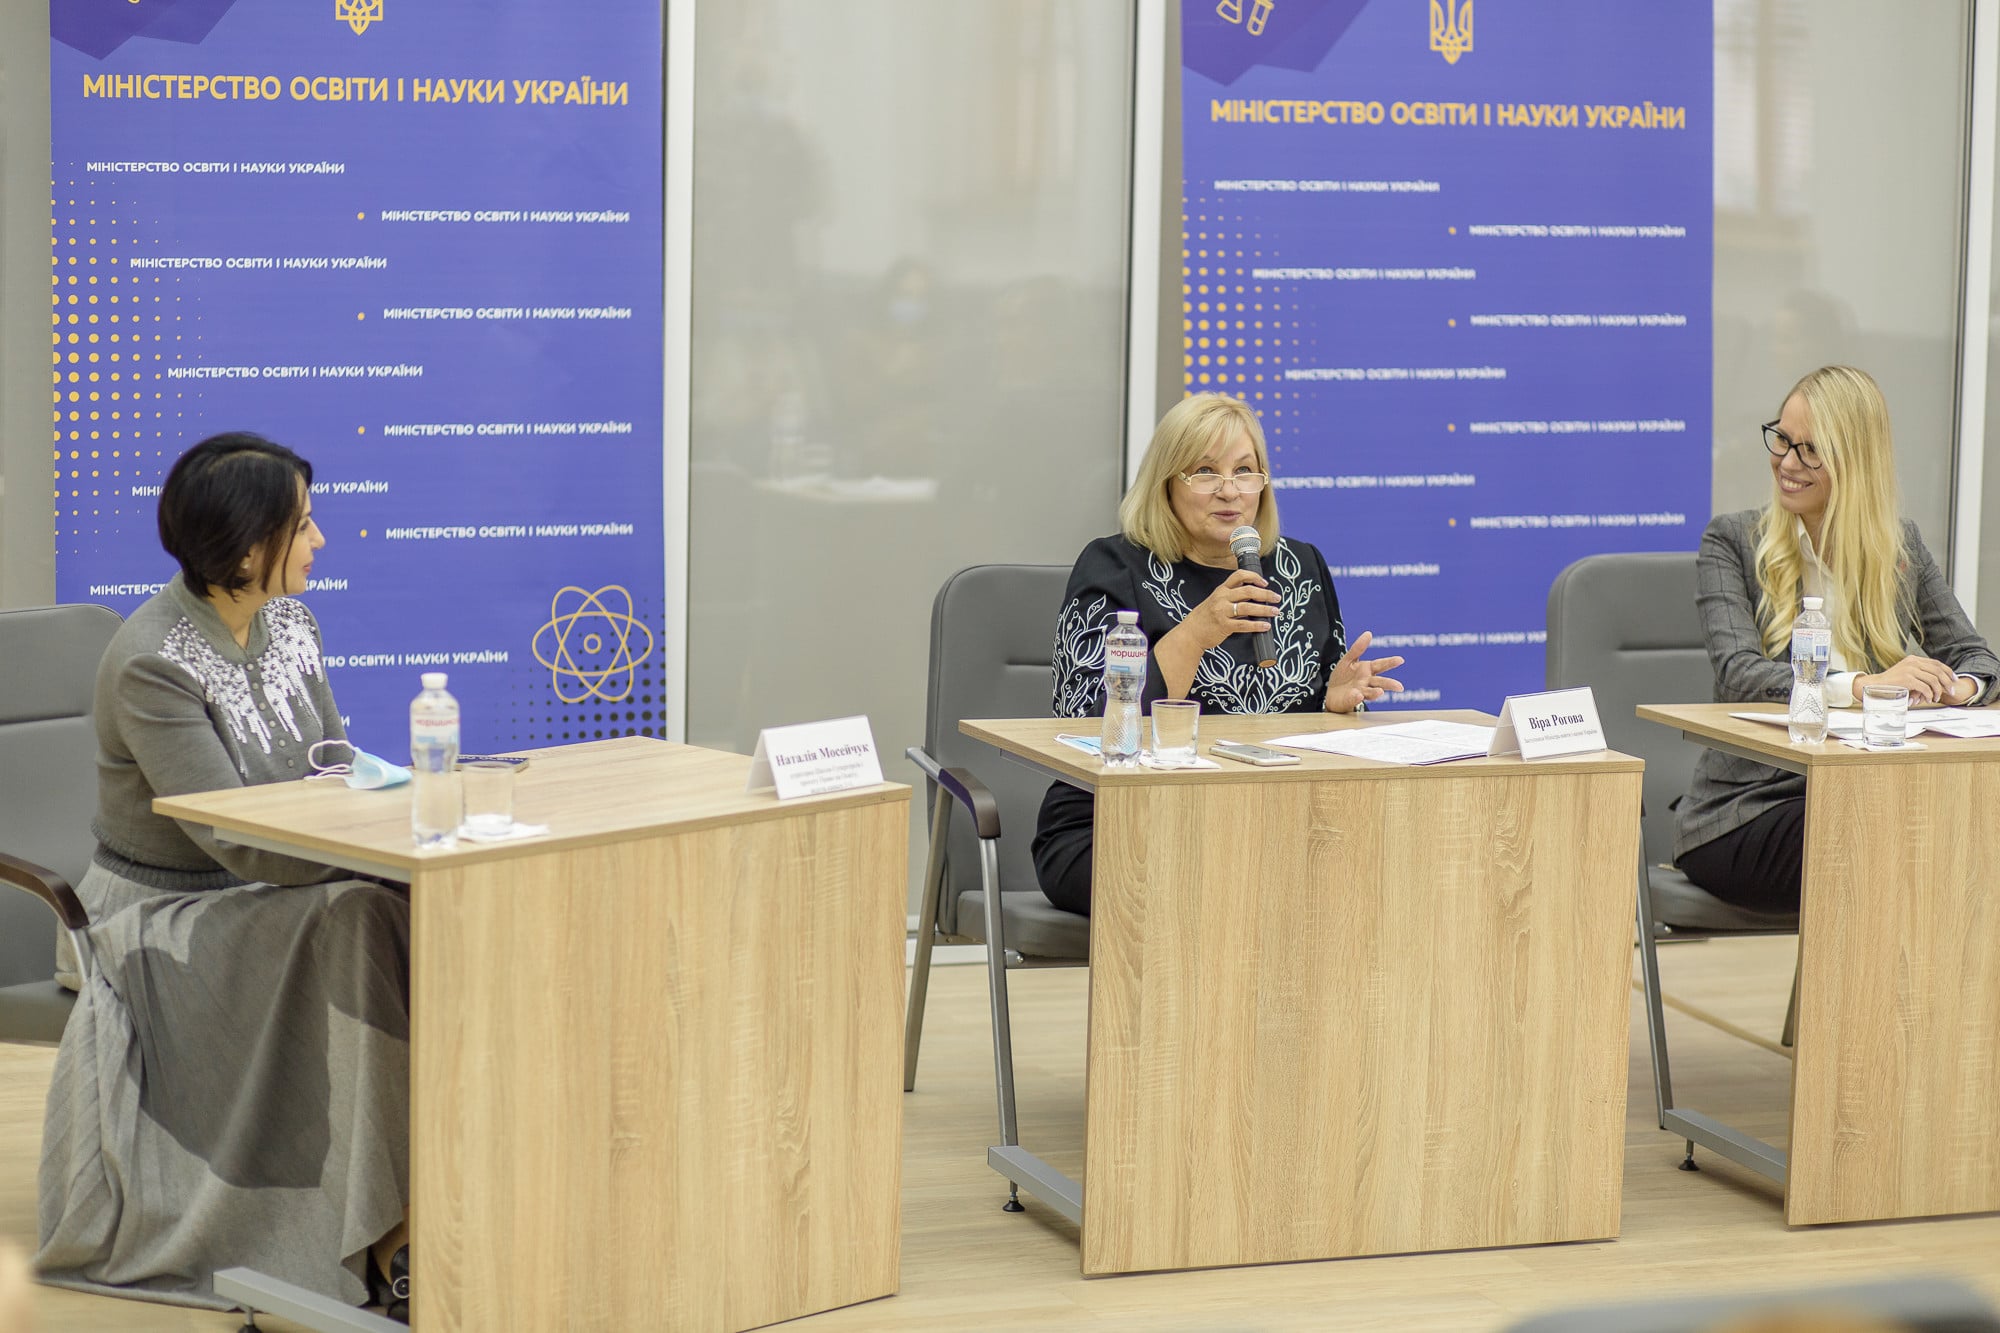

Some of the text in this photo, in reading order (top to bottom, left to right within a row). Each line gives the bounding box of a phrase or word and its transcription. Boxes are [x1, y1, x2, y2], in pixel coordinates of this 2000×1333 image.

[83, 74, 629, 106] МІНІСТЕРСТВО ОСВІТИ І НАУКИ УКРАЇНИ
[1211, 99, 1685, 129] МІНІСТЕРСТВО ОСВІТИ І НАУКИ УКРАЇНИ
[86, 161, 180, 173] МІНІСТЕРСТВО
[182, 162, 230, 173] ОСВІТИ
[240, 162, 286, 174] НАУКИ
[288, 161, 345, 174] УКРАЇНИ
[381, 210, 472, 222] МІНІСТЕРСТВО
[473, 210, 521, 222] ОСВІТИ
[530, 211, 574, 222] НАУКИ
[575, 210, 630, 223] УКРАЇНИ
[130, 257, 223, 269] МІНІСТЕРСТВО
[225, 257, 273, 269] ОСВІТИ
[283, 257, 329, 269] НАУКИ
[331, 255, 387, 269] УКРАЇНИ
[383, 307, 474, 319] МІНІСТЕРСТВО
[475, 307, 523, 319] ОСВІТИ
[532, 307, 576, 319] НАУКИ
[577, 306, 632, 319] УКРАЇНИ
[167, 366, 260, 379] МІНІСТЕРСТВО
[262, 366, 310, 378] ОСВІТИ
[319, 365, 365, 378] НАУКИ
[367, 363, 423, 377] УКРАЇНИ
[384, 423, 475, 436] МІНІСТЕРСТВО
[476, 423, 525, 436] ОСВІТИ
[533, 423, 577, 435] НАУКИ
[578, 420, 632, 434] УКРАЇНИ
[332, 480, 389, 494] УКРАЇНИ
[385, 526, 477, 539] МІНІСТЕРСТВО
[478, 525, 526, 538] ОСВІТИ
[535, 525, 578, 537] НАУКИ
[580, 522, 634, 536] УКРАЇНИ
[349, 655, 395, 666] ОСВІТИ
[406, 653, 449, 665] НАУКИ
[453, 650, 508, 664] УКРАЇНИ
[1528, 712, 1584, 731] Віра Рогова
[776, 743, 869, 766] Наталія Мосейчук
